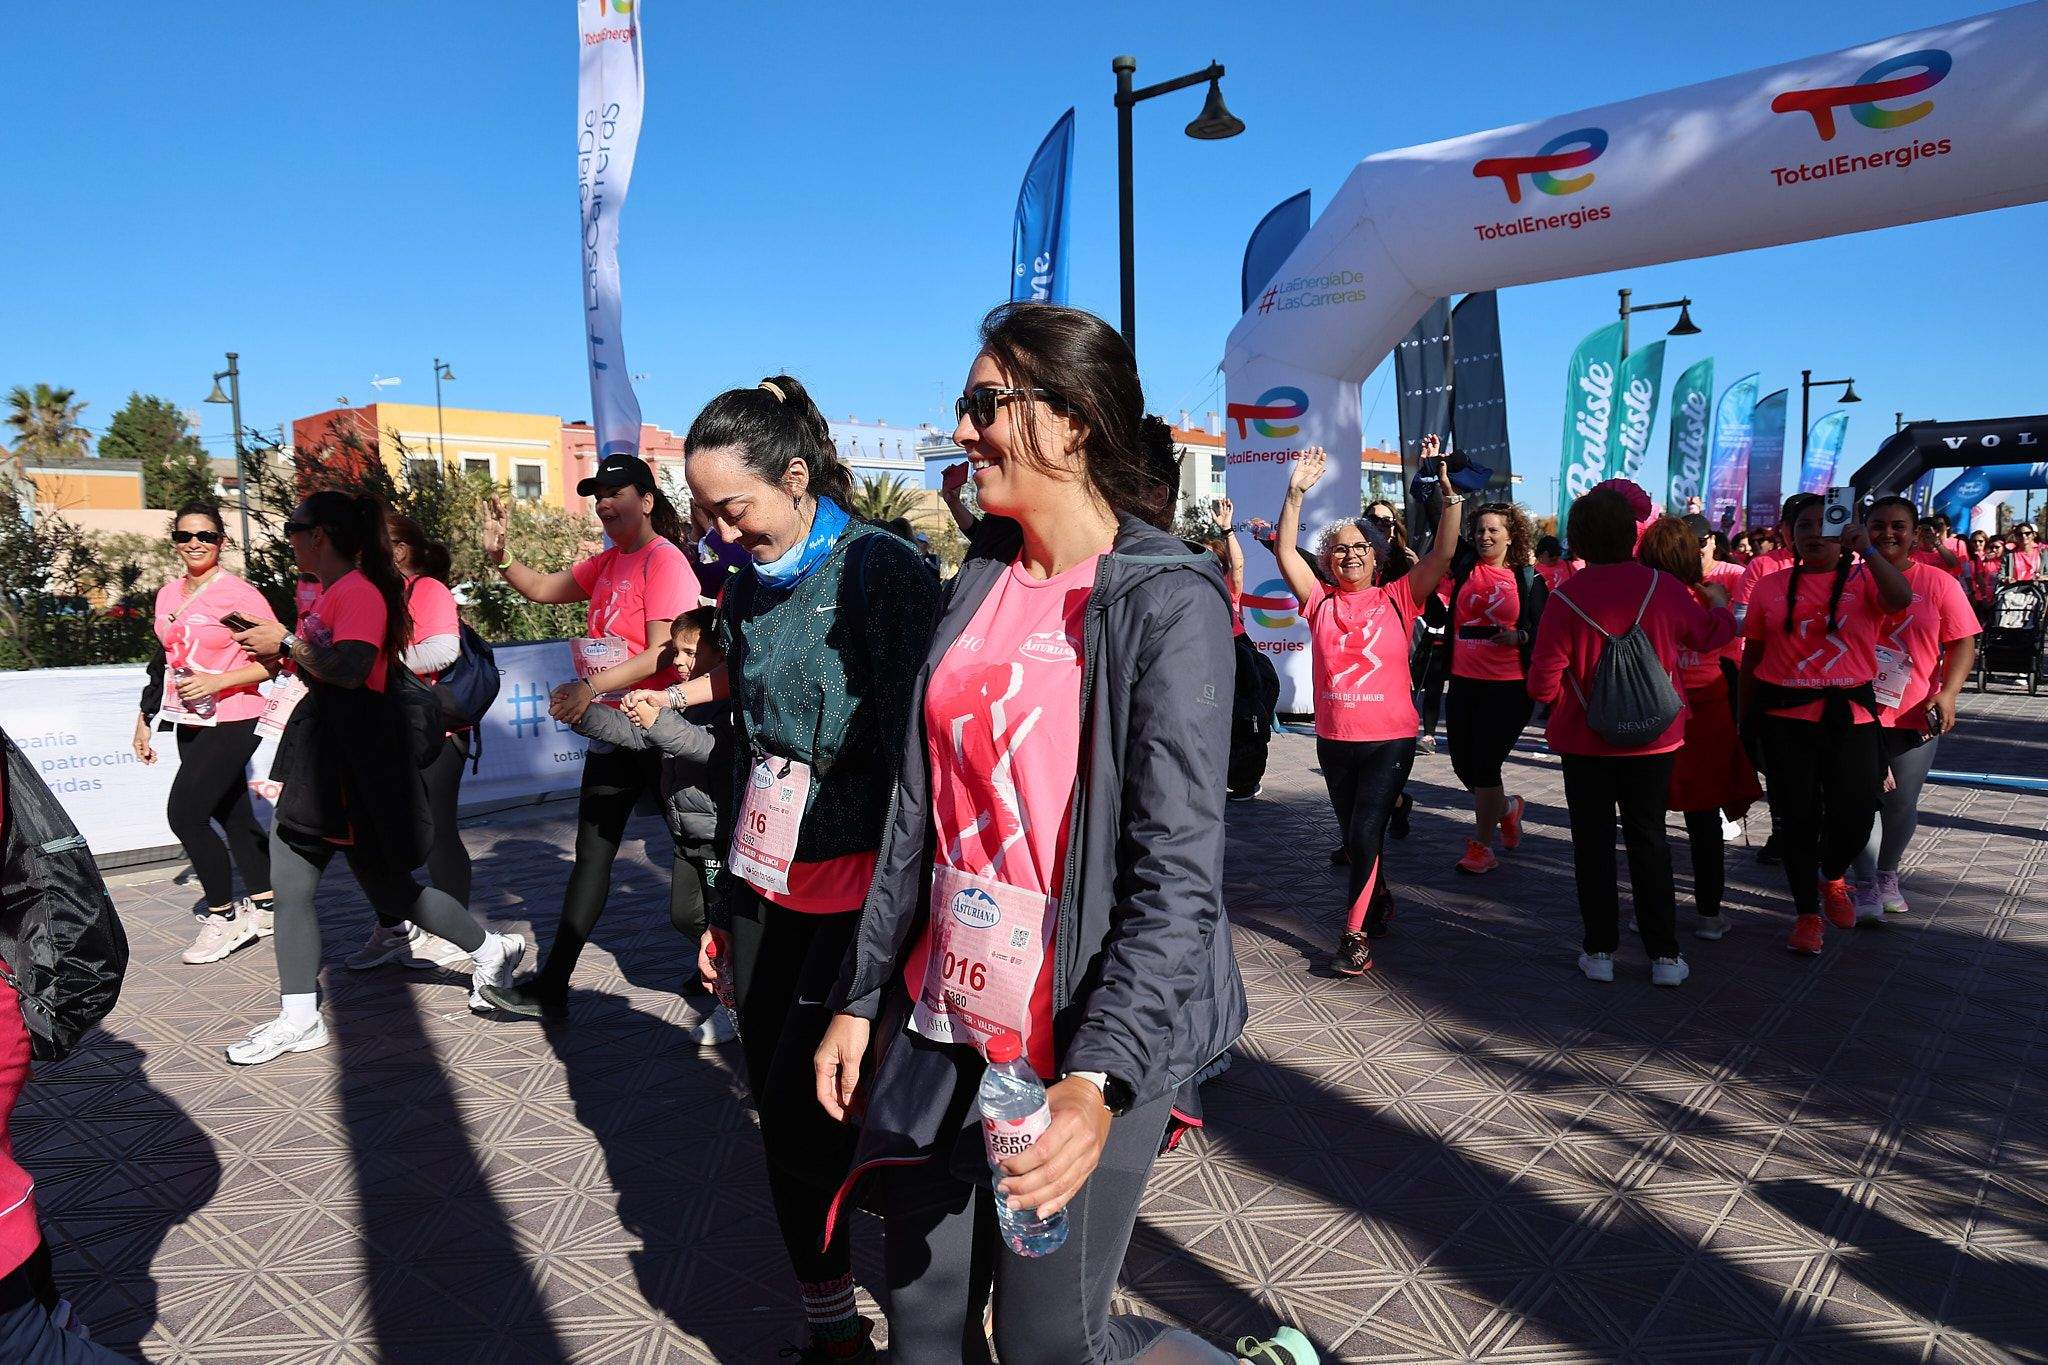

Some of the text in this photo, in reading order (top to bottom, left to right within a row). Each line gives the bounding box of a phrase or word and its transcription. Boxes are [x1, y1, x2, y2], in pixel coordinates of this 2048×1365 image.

[1771, 137, 1952, 187] TotalEnergies
[1474, 204, 1611, 241] TotalEnergies
[1277, 288, 1366, 311] LasCarreras
[1400, 334, 1450, 348] VOLVO
[1405, 384, 1453, 397] VOLVO
[1457, 398, 1504, 410] VOLVO
[1565, 361, 1614, 500] Batiste
[1614, 377, 1653, 482] atiste
[41, 750, 142, 774] patrocin
[953, 896, 995, 923] ASTURIANA
[942, 951, 987, 992] 016
[990, 1133, 1032, 1146] ZERO
